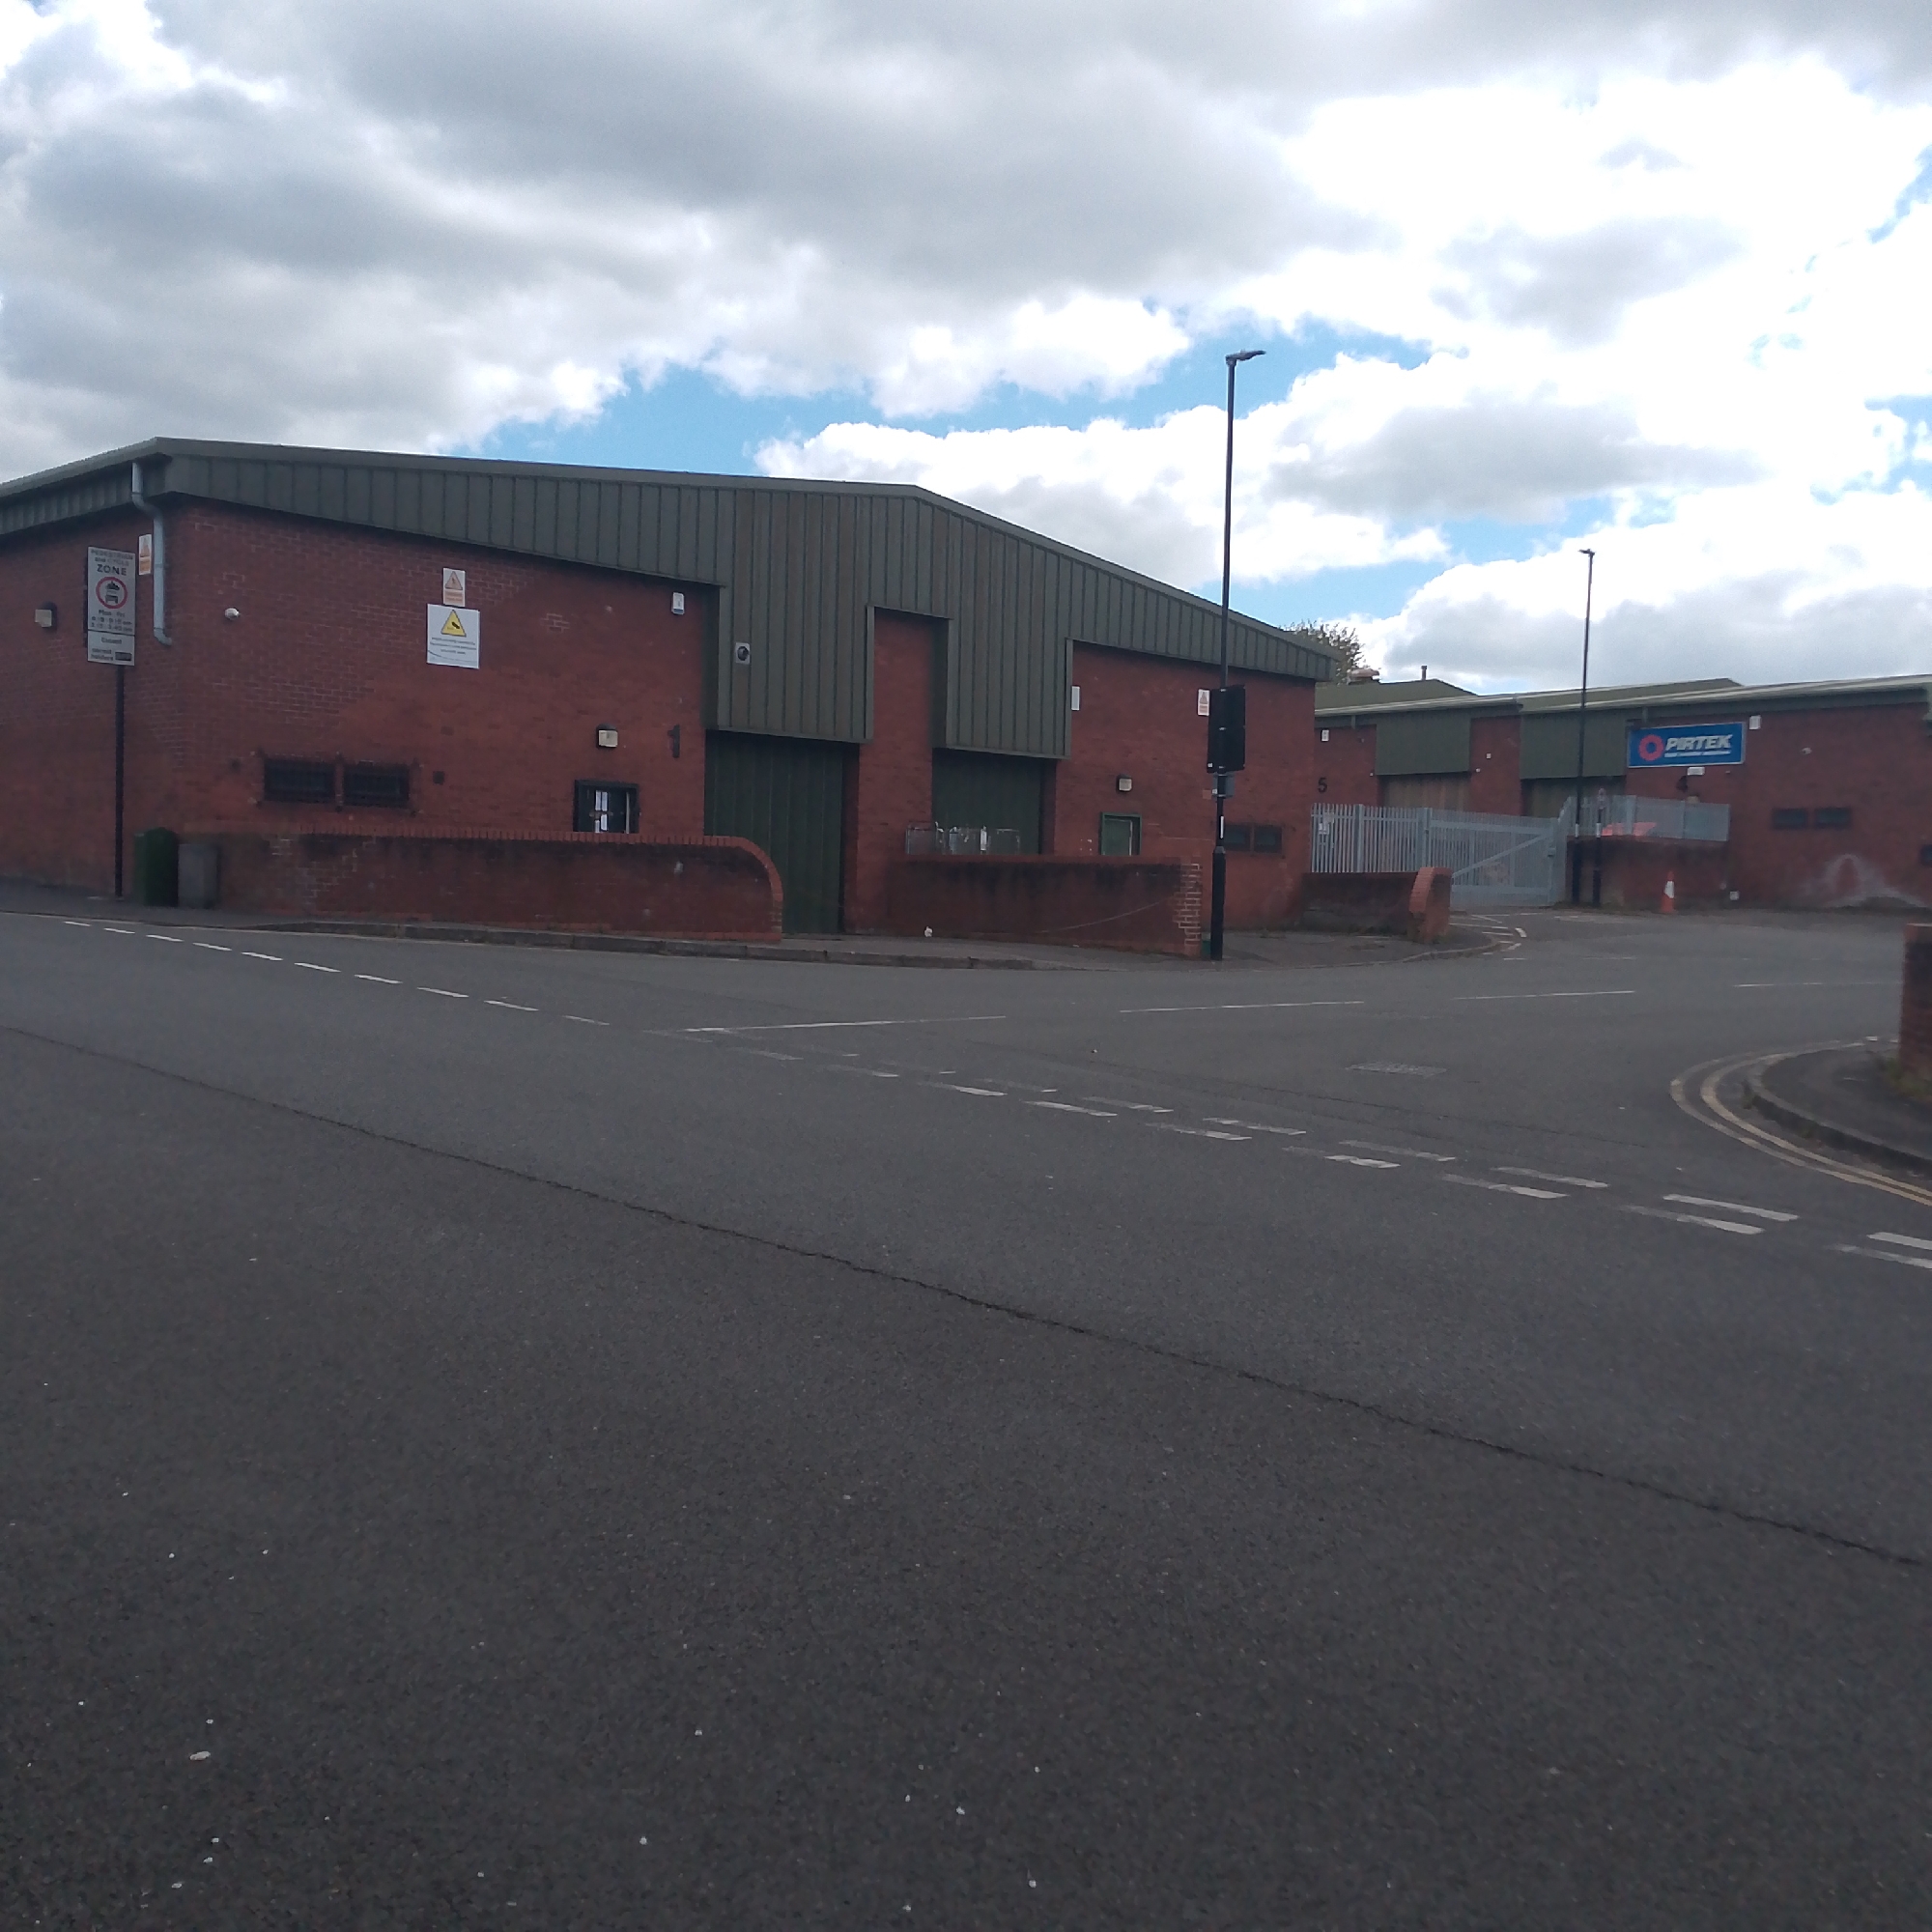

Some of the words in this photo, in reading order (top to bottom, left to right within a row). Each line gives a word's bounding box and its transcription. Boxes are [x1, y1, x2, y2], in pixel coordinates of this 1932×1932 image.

[97, 563, 127, 576] ZONE
[1664, 734, 1734, 751] PIRTEK
[1318, 777, 1328, 793] 5
